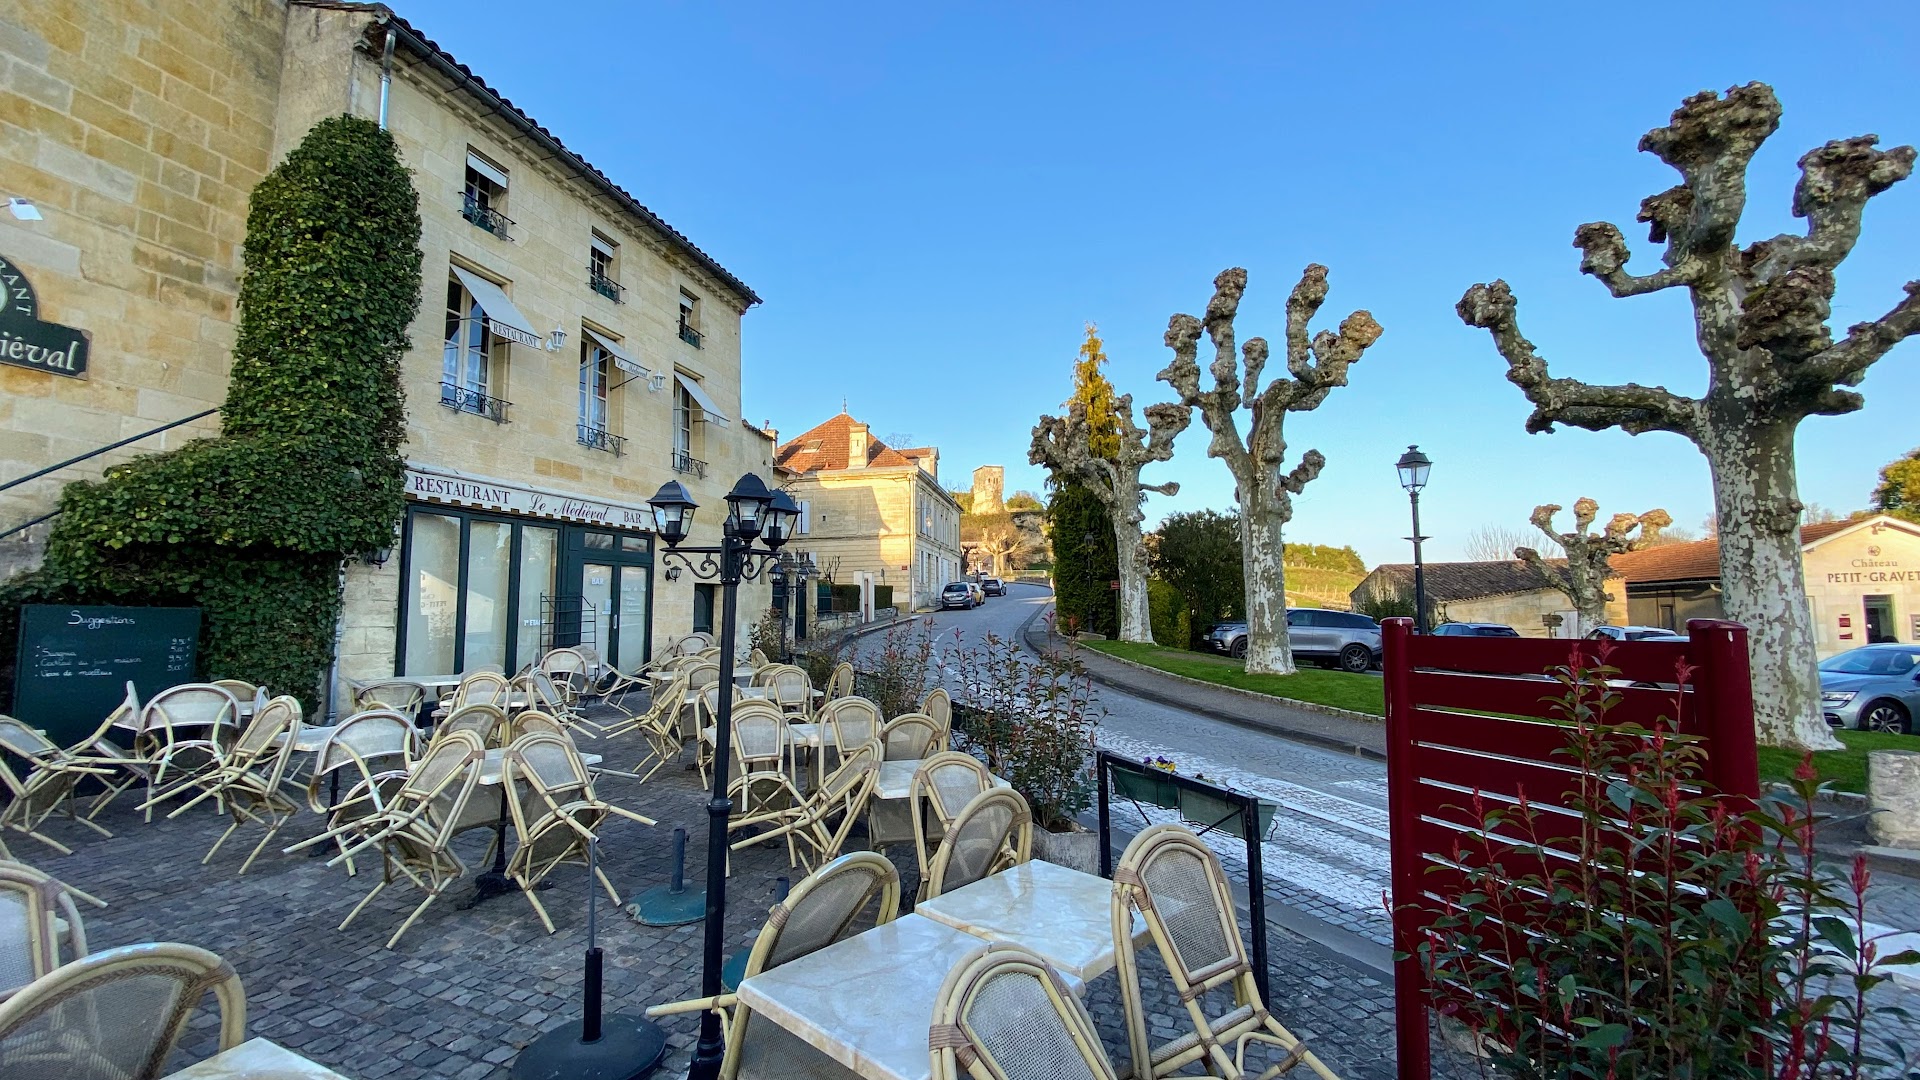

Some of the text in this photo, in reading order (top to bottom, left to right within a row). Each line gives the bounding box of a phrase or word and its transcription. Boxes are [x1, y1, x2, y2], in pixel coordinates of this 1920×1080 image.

[493, 321, 538, 348] RESTAURANT
[414, 476, 511, 505] RESTAURANT
[528, 493, 547, 512] Le
[553, 498, 610, 522] Médiéval
[623, 511, 642, 525] BAR
[1851, 559, 1898, 568] Château
[591, 577, 605, 585] BAR
[67, 609, 136, 629] Suggestions
